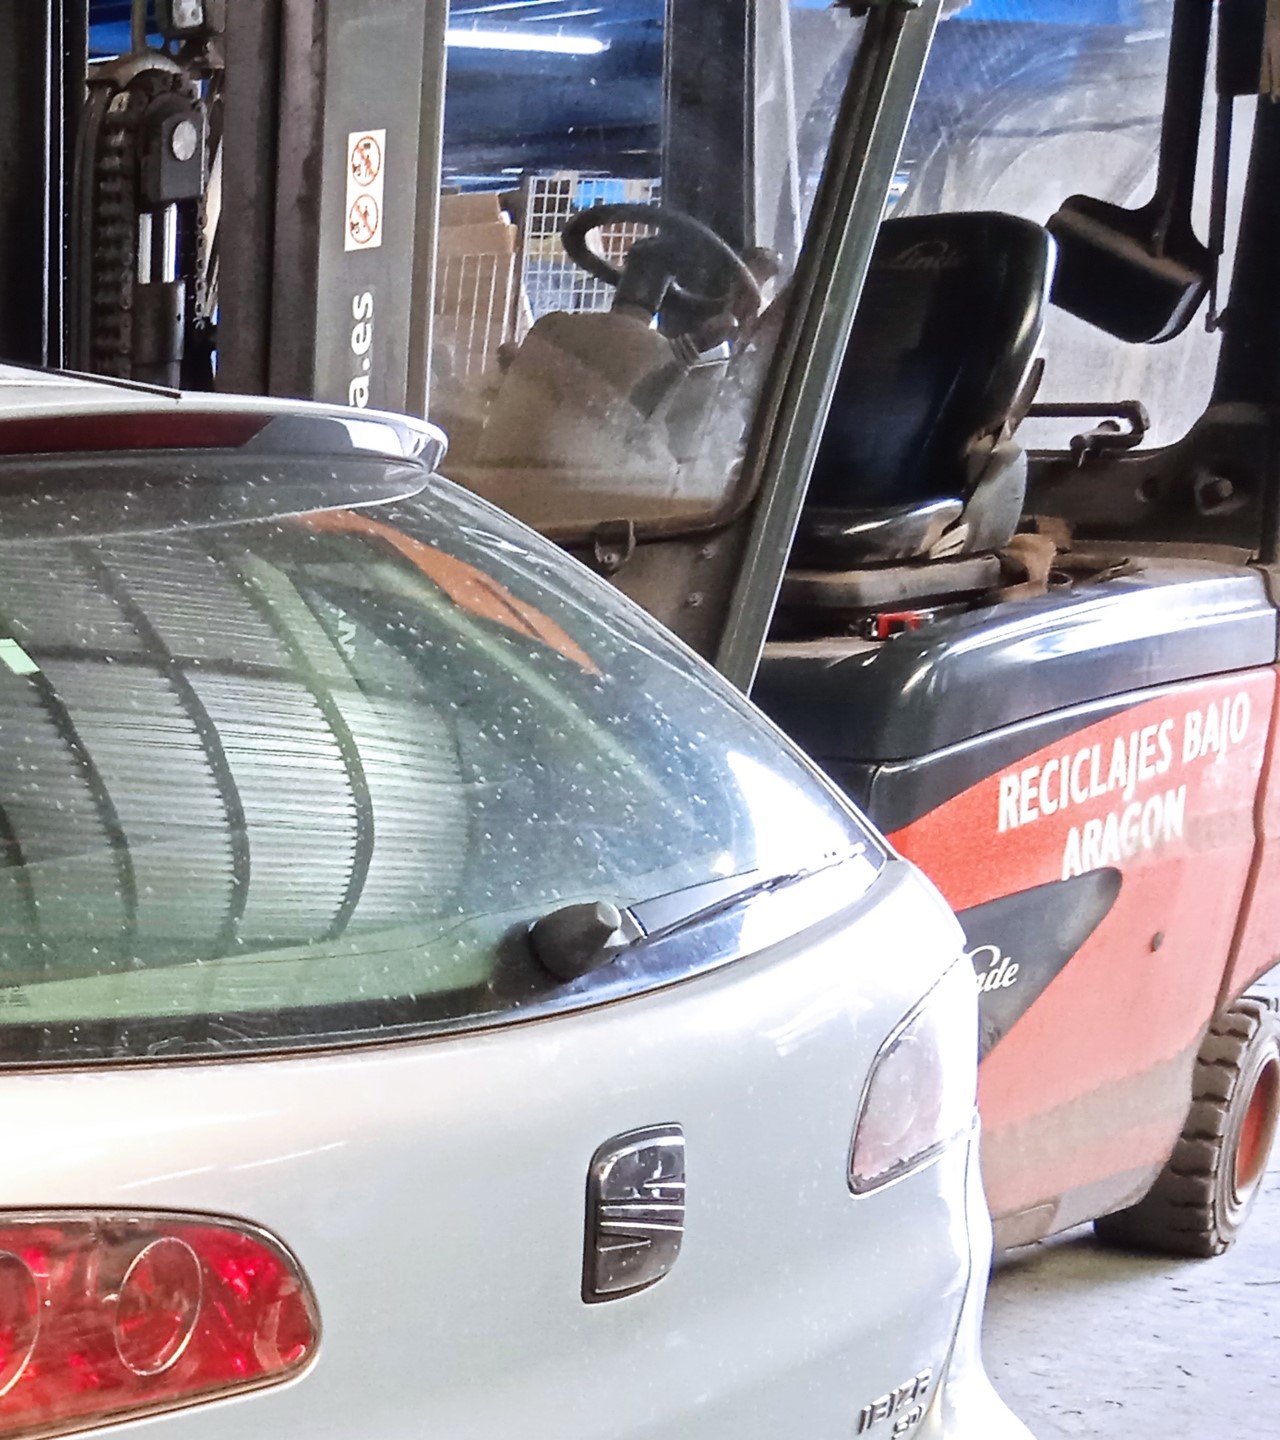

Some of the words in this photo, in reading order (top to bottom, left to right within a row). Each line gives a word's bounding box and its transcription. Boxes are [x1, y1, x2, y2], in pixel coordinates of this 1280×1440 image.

[998, 718, 1174, 833] RECICLAJES
[1182, 691, 1251, 765] BAJO
[1061, 785, 1186, 881] ARAGON
